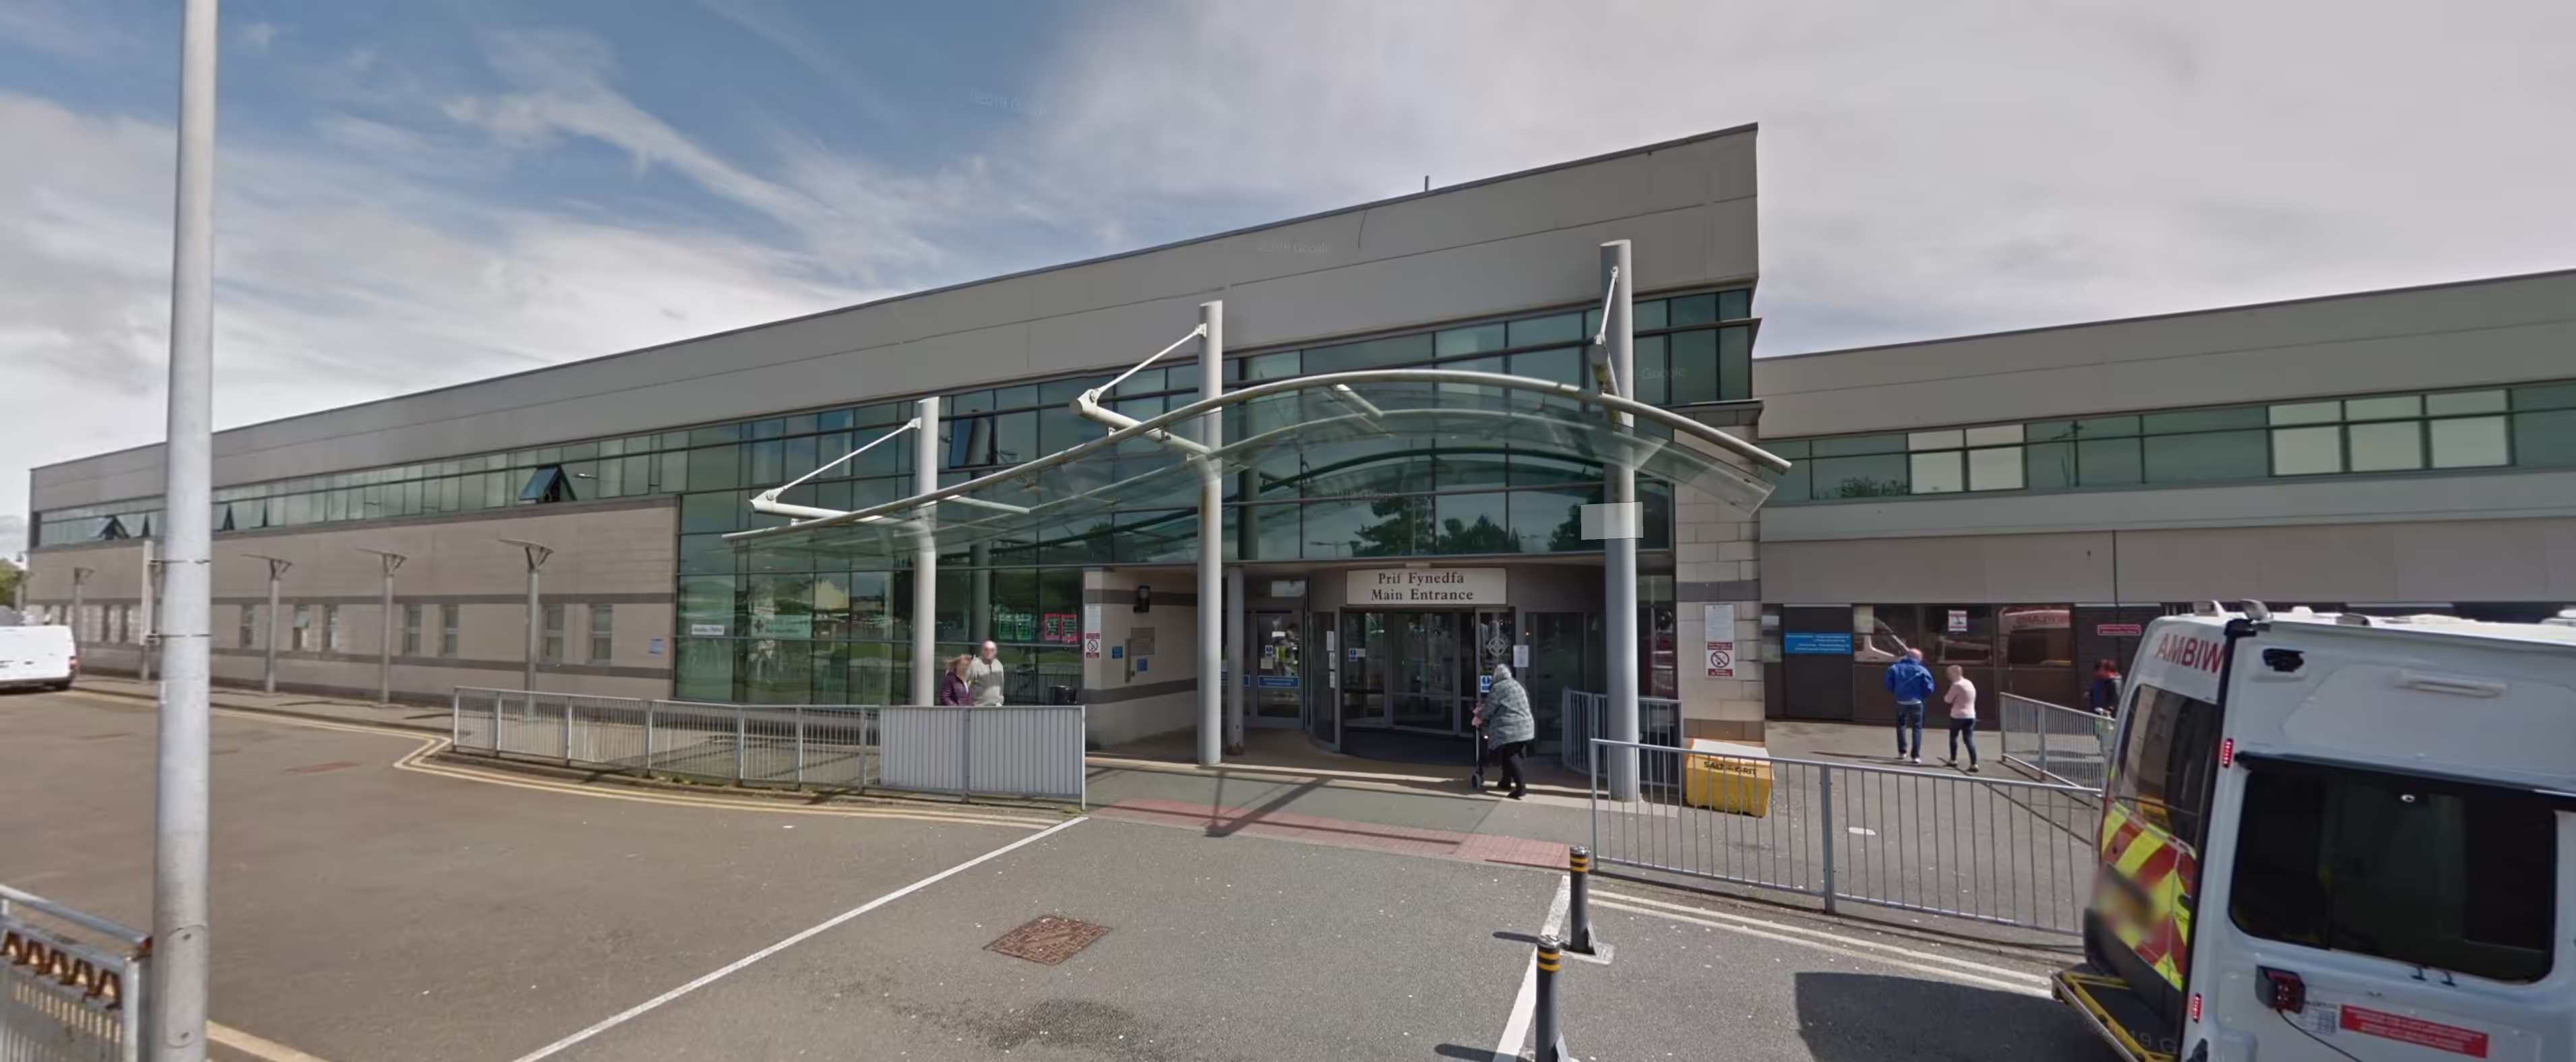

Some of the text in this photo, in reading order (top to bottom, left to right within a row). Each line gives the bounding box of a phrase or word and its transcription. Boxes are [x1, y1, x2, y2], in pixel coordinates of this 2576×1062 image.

[1378, 571, 1465, 586] Prif Fynedfa
[1371, 588, 1473, 600] Main Entrance
[2154, 633, 2224, 673] AMBIW
[1704, 761, 1723, 770] SALT
[1735, 766, 1756, 775] GRIT
